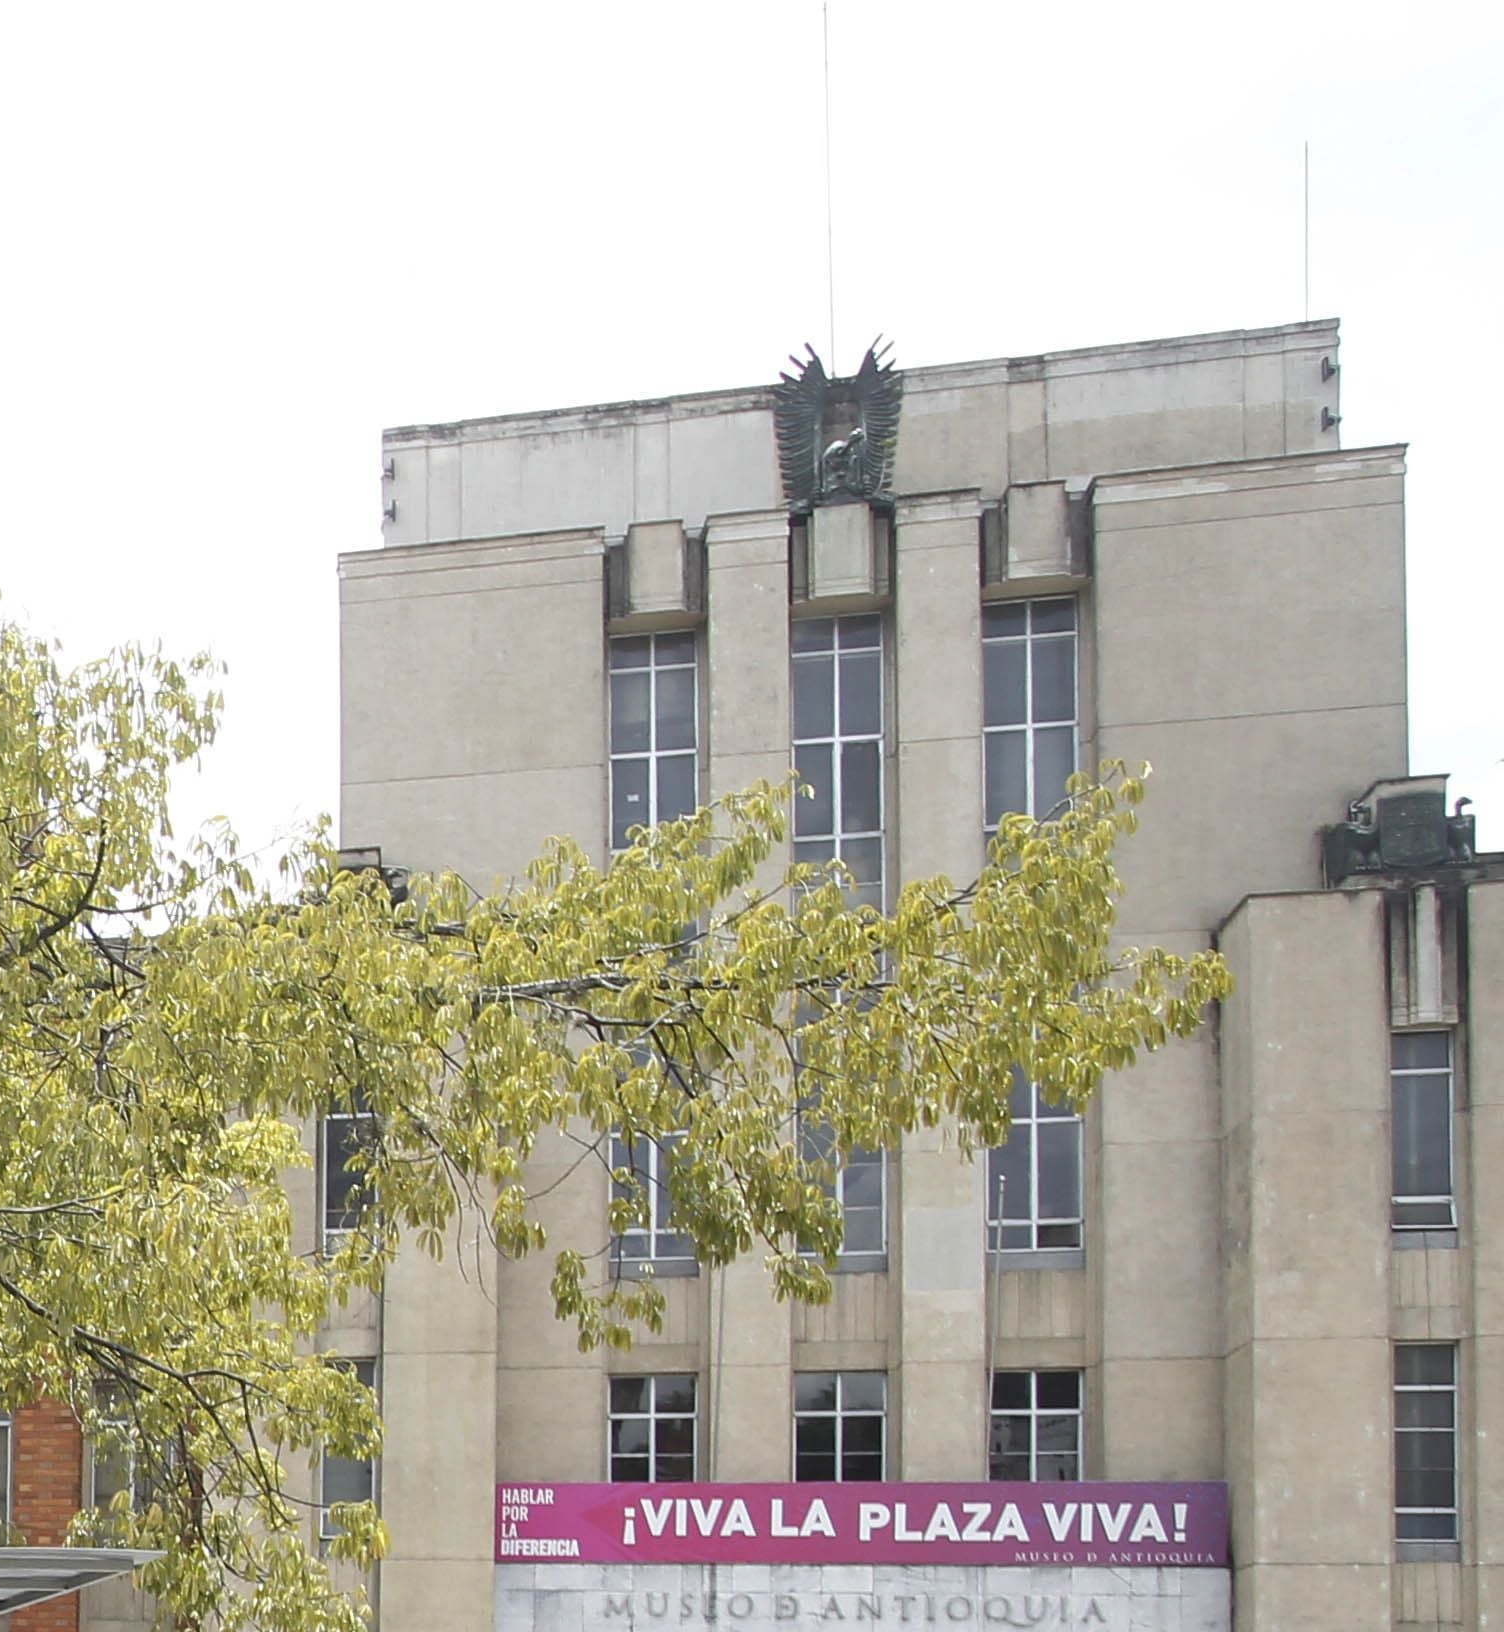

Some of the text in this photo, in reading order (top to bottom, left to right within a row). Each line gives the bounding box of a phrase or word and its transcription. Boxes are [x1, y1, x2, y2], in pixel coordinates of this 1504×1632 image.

[502, 1488, 554, 1505] HABLAR
[502, 1506, 529, 1521] POR
[623, 1498, 1188, 1545] ¡VIVA LA PLAZA VIVA!
[501, 1523, 518, 1538] LA
[500, 1539, 580, 1557] DIFERENCIA
[1015, 1551, 1075, 1563] MUSEO
[1108, 1551, 1216, 1565] ANTIOQUIA
[603, 1592, 755, 1620] MUSEO
[821, 1592, 1107, 1627] ANTIOQUIA
